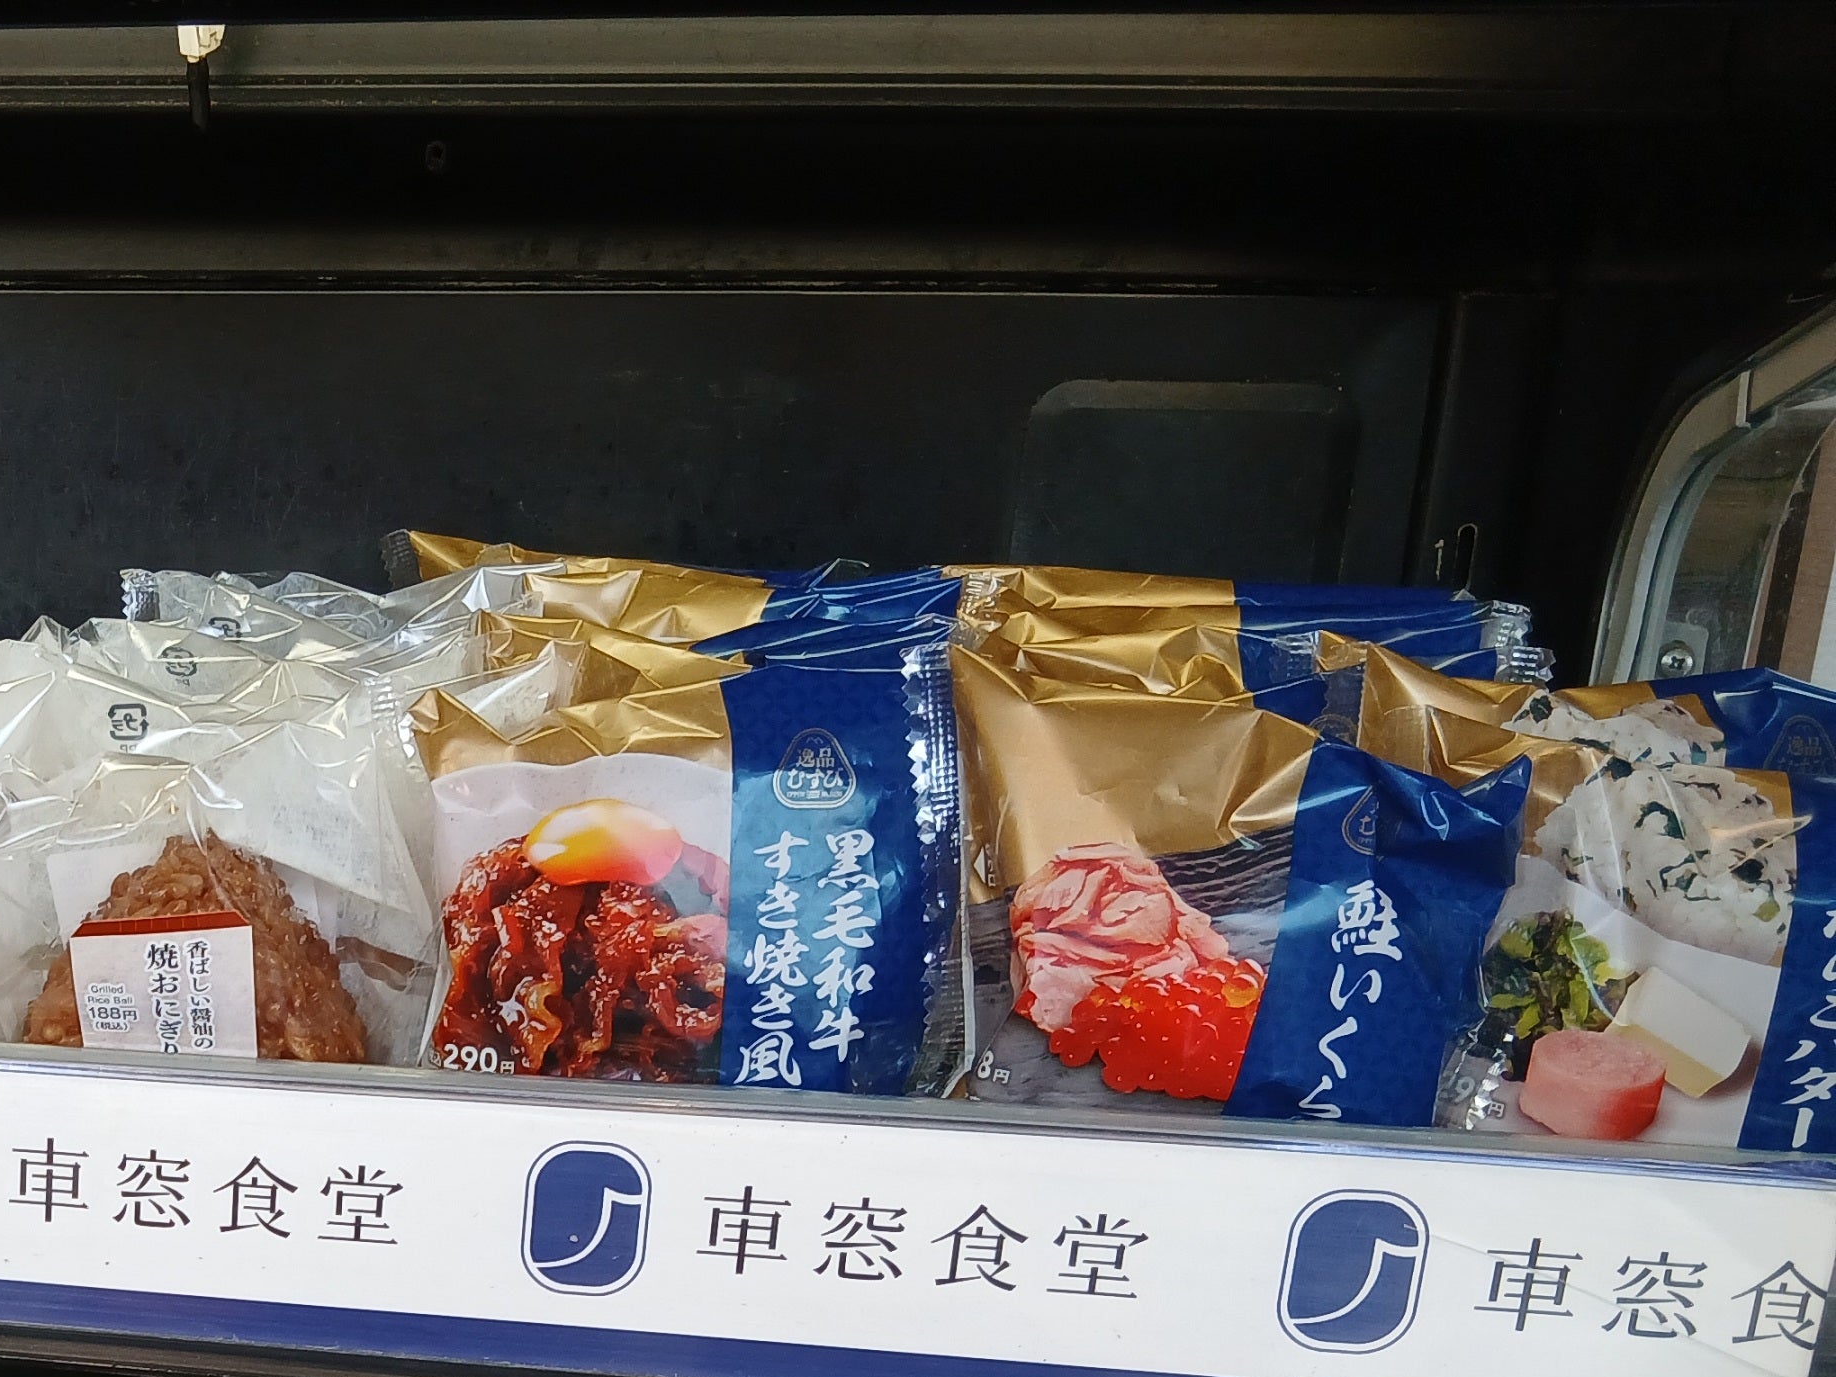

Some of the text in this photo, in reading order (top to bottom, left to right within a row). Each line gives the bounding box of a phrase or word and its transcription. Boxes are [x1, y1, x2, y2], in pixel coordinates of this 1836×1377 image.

[787, 767, 844, 790] むすび
[796, 747, 835, 768] 逸品
[147, 942, 183, 1055] 焼おにぎり
[186, 940, 214, 1050] 香ばしい醤油の
[735, 830, 810, 1087] すき焼き風
[808, 830, 880, 1062] 黒毛和牛
[88, 1006, 138, 1021] 188円
[8, 1137, 406, 1247] 車窓食堂
[696, 1185, 1150, 1303] 車窓食堂
[1471, 1237, 1824, 1352] 車窓食
